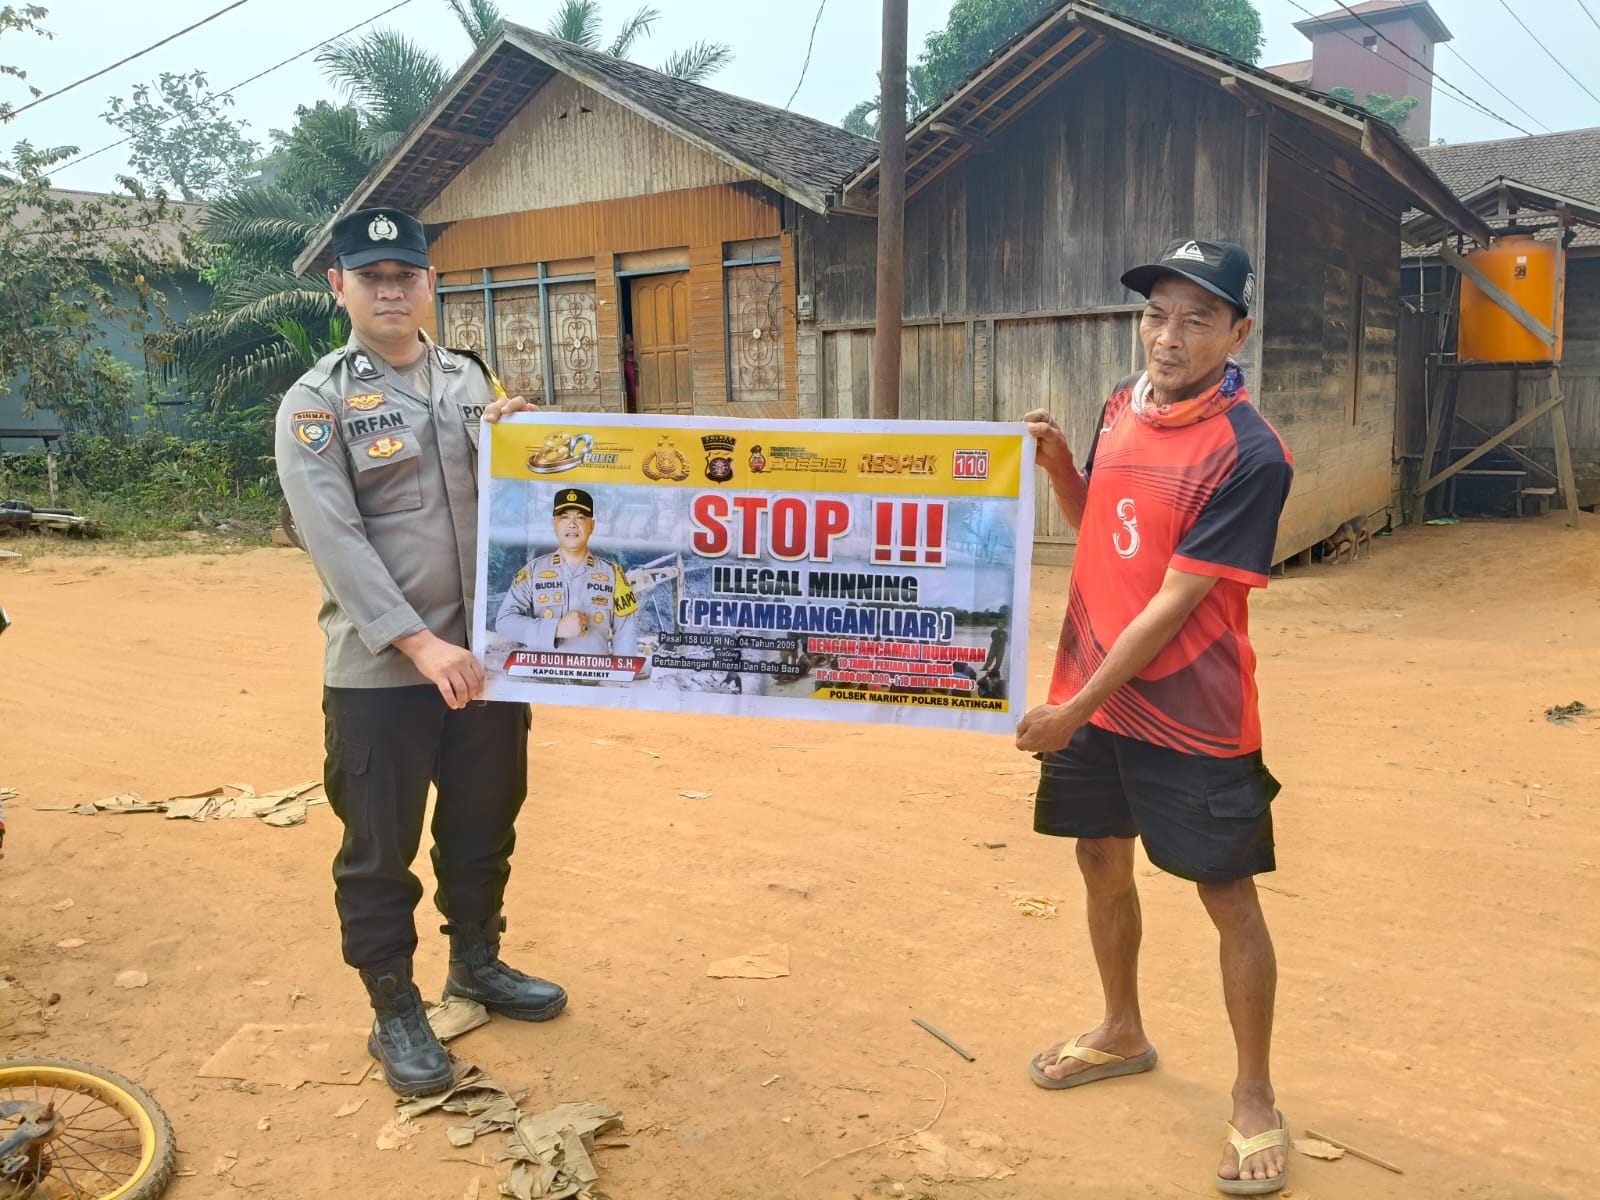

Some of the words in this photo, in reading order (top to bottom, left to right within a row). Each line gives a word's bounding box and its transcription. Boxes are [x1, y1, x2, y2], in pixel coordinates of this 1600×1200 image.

[463, 405, 485, 418] PO
[348, 412, 403, 437] IRFAN
[583, 453, 619, 464] POLRI
[859, 454, 938, 475] RESPEK
[956, 457, 986, 474] 110
[693, 494, 850, 559] STOP
[873, 501, 945, 565] !!!
[586, 582, 613, 593] POLRI
[713, 567, 803, 597] ILLEGAL
[808, 571, 918, 603] MINNING
[660, 635, 682, 644] Pasal
[684, 635, 698, 644] 158
[700, 636, 712, 645] UU
[714, 637, 722, 645] RI
[724, 637, 737, 646] No.
[739, 637, 749, 646] 04
[752, 638, 775, 648] Tahun
[776, 640, 796, 649] 2009
[808, 637, 856, 654] DENGAN
[858, 641, 920, 659] ANCAMAN
[922, 645, 987, 663] HUKUMAN
[516, 652, 537, 664] IPTU
[540, 654, 564, 665] BUDI
[617, 658, 636, 670] S.H.
[654, 657, 711, 671] Pertambangan
[712, 660, 741, 670] Mineral
[743, 661, 758, 670] Dan
[761, 662, 779, 672] Batu
[781, 664, 800, 674] Bara
[927, 663, 953, 675] DENDA
[533, 668, 574, 676] KAPOLSEK
[576, 670, 610, 678] MARIKIT
[830, 690, 866, 701] POLSEK
[869, 693, 909, 704] MARIKIT
[912, 696, 949, 706] POLRES
[952, 698, 1002, 710] KATINGAN
